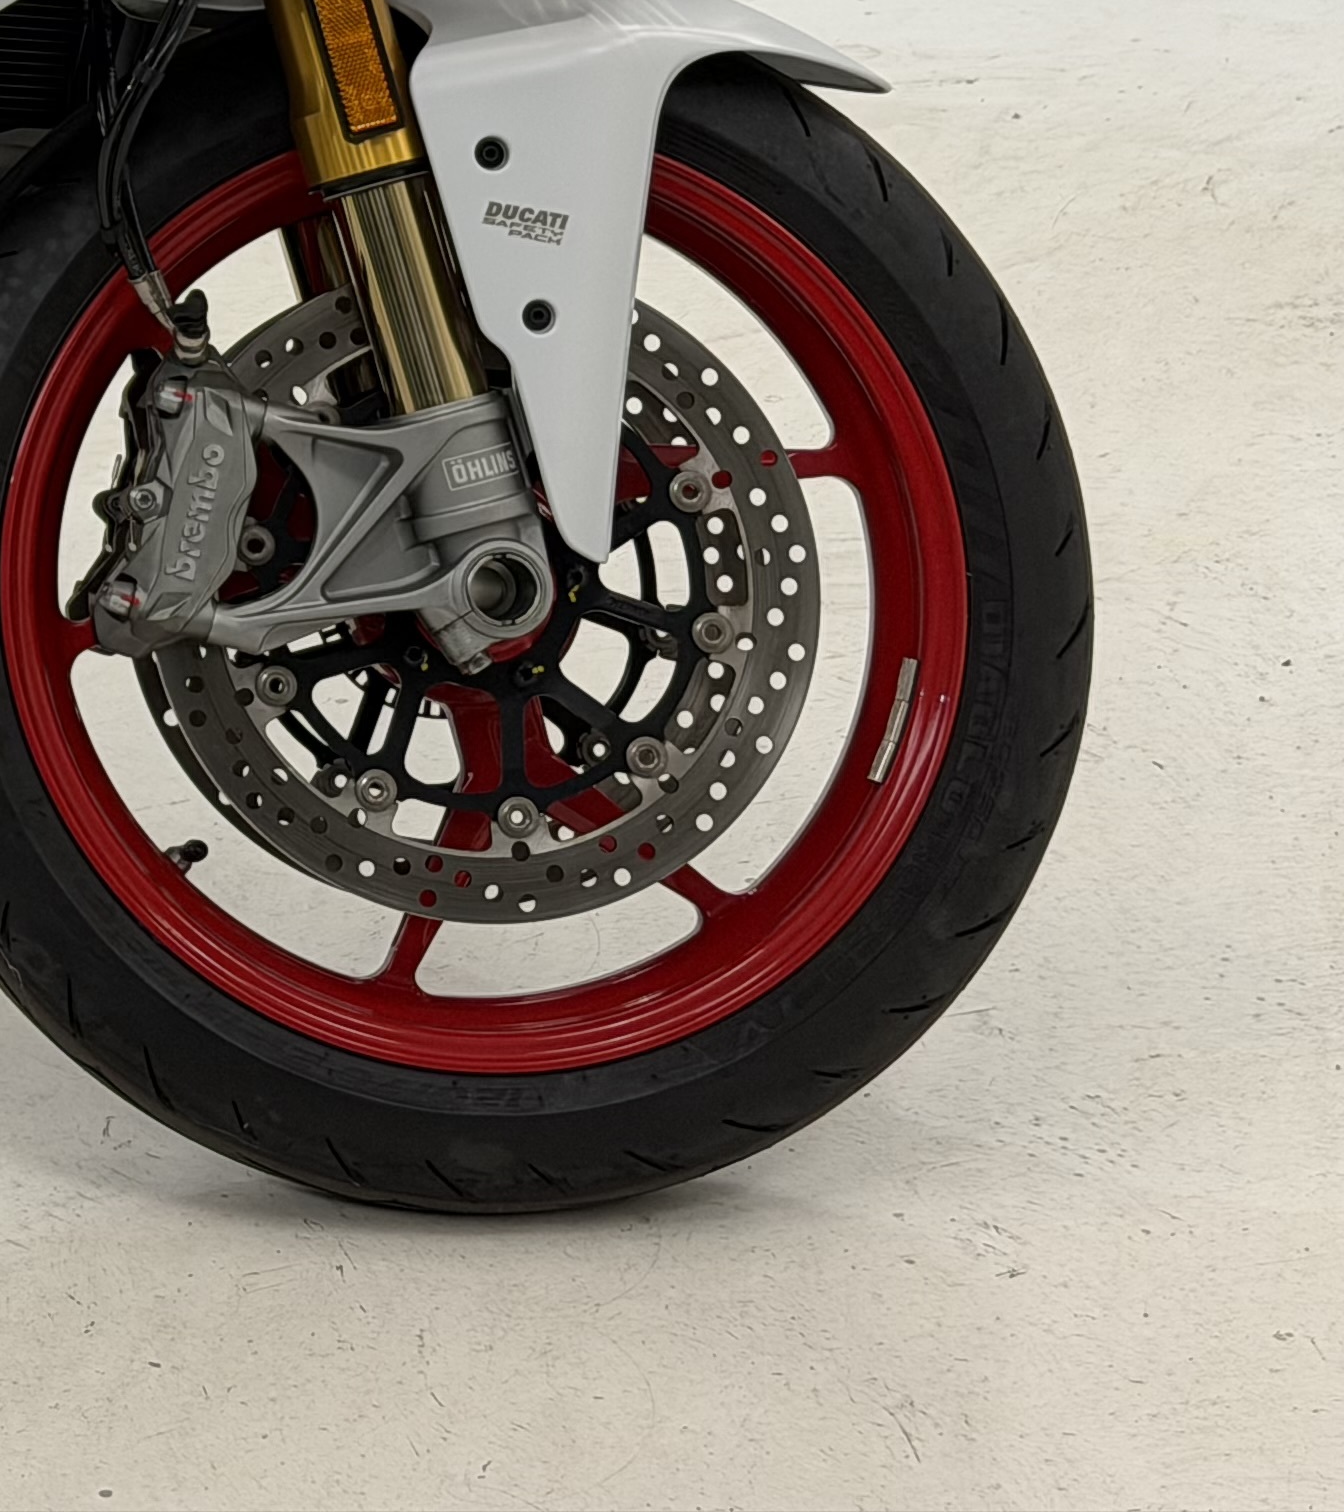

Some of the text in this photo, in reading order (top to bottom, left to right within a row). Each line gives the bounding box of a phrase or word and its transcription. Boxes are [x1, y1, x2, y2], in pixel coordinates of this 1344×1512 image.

[482, 217, 564, 237] SAFETY
[485, 201, 569, 230] DUCATI
[450, 450, 516, 484] ÖHLINS
[164, 444, 224, 581] brembo
